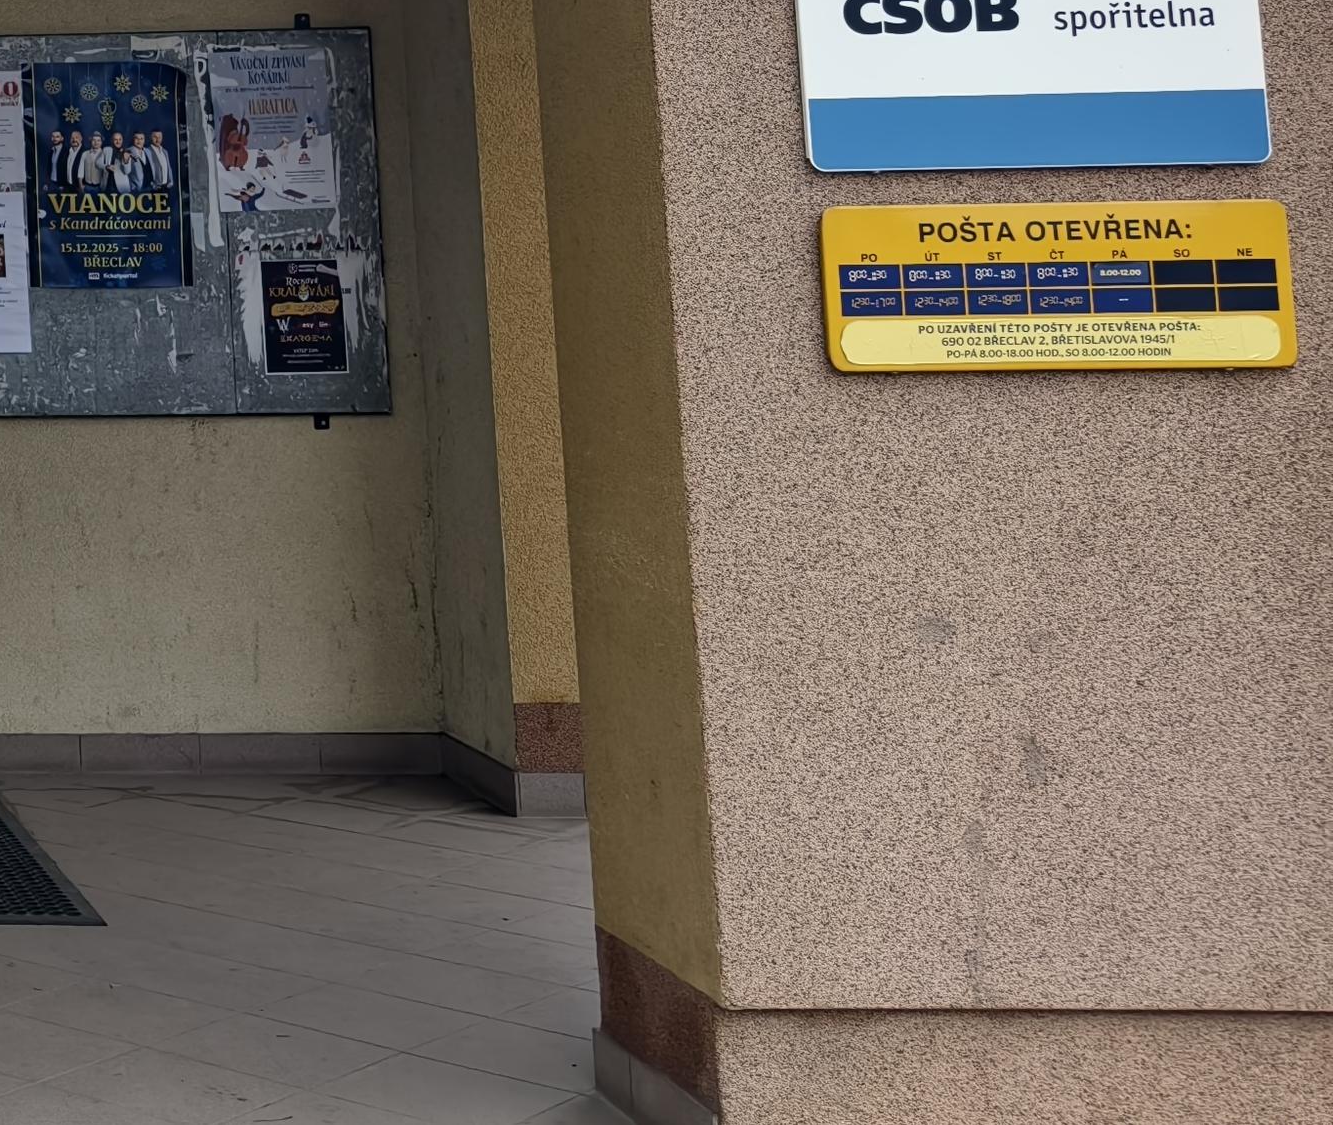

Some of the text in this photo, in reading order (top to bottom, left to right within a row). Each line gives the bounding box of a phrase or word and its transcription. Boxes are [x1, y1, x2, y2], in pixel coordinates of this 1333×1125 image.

[1054, 1, 1215, 36] spořitelna
[47, 193, 171, 215] VIANOCE
[48, 216, 172, 232] s Kandráčovcami
[918, 213, 1193, 244] POŠTA OTEVŘENA:
[60, 243, 119, 254] 15.12.2025
[132, 242, 163, 254] 18:00
[1049, 248, 1064, 260] ČT
[1111, 247, 1128, 260] PÁ
[1172, 248, 1191, 259] SO
[1237, 247, 1253, 258] NE
[860, 252, 878, 263] PO
[924, 250, 940, 262] ÚT
[986, 250, 1003, 261] ST
[83, 256, 143, 269] BŘECLAV
[918, 319, 1201, 335] PO UZAVŘENÍ TÉTO POŠTY JE OTEVŘENA POŠTA:
[941, 336, 964, 347] 690
[966, 335, 982, 347] 02
[984, 332, 1036, 346] BŘECLAV
[1051, 332, 1138, 345] BŘETISLAVOVA
[1140, 334, 1176, 345] 1945/1
[946, 347, 978, 359] PO-PÁ
[979, 349, 1034, 359] 8.00-18.00
[1065, 348, 1080, 358] SO
[1082, 347, 1135, 358] 8.00-12.00
[1137, 346, 1172, 357] HODIN
